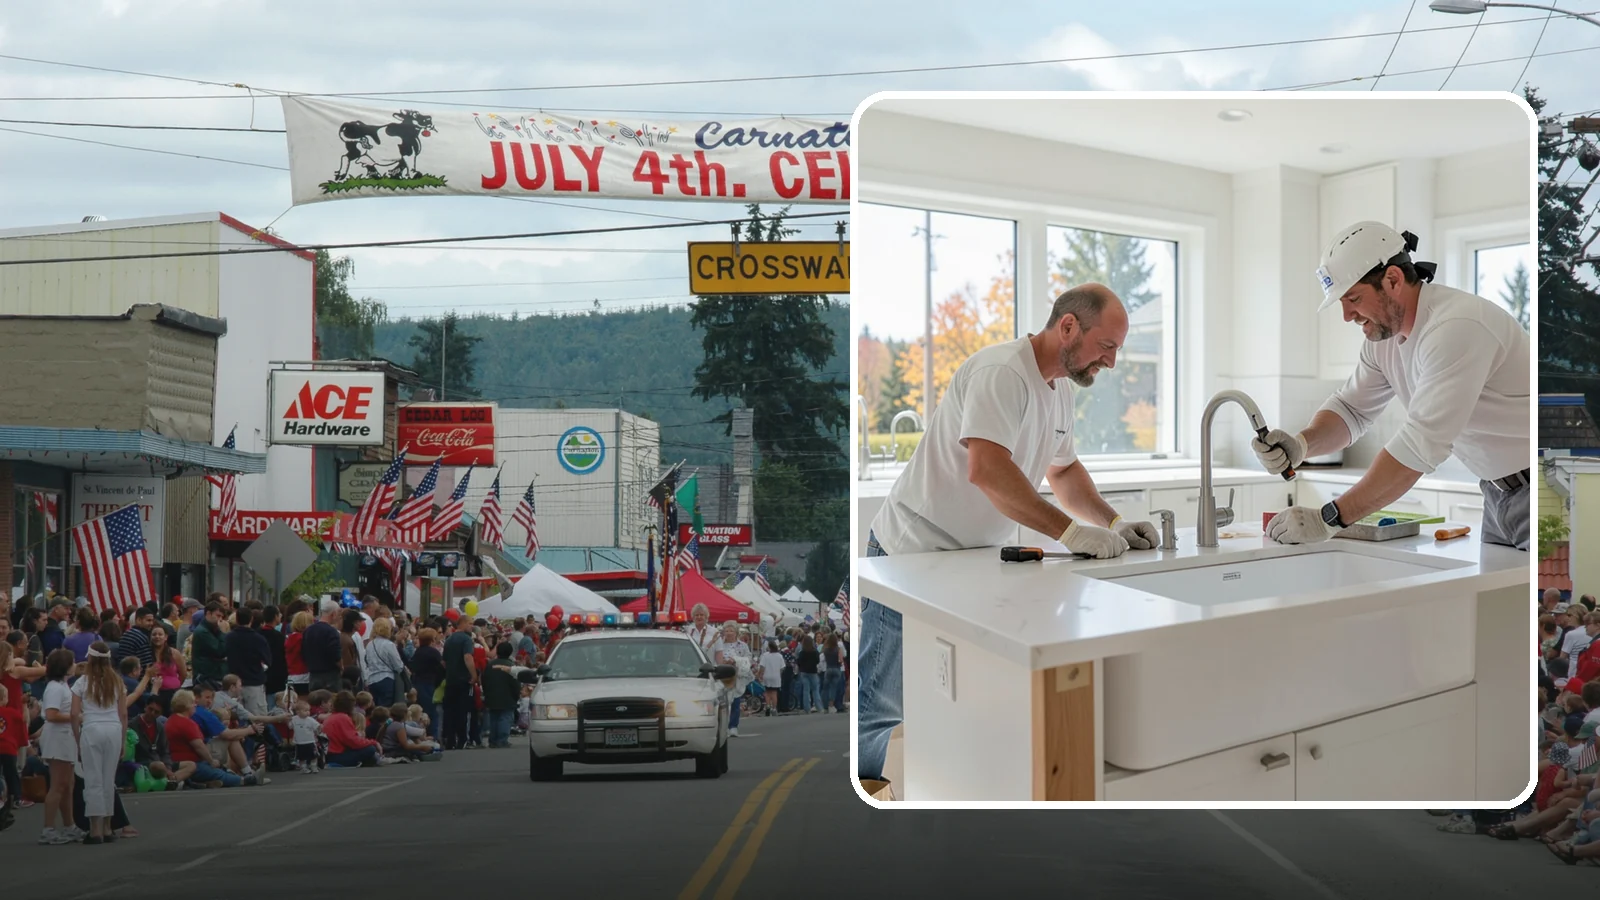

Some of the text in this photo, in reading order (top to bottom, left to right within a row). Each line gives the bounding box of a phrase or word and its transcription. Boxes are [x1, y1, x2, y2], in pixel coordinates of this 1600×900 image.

[695, 121, 850, 150] Carnat
[481, 141, 605, 191] JULY
[632, 150, 746, 198] 4th.
[697, 254, 850, 280] CROSSWA
[283, 380, 373, 419] ACE
[406, 410, 452, 422] CEDAR
[283, 421, 371, 436] Hardware
[416, 428, 477, 447] Coca-Cola
[354, 467, 384, 481] Simpl
[96, 485, 124, 495] Vincent
[126, 485, 136, 494] de
[138, 486, 155, 495] Paul
[688, 526, 741, 535] CRNATION
[699, 535, 730, 543] GLASS
